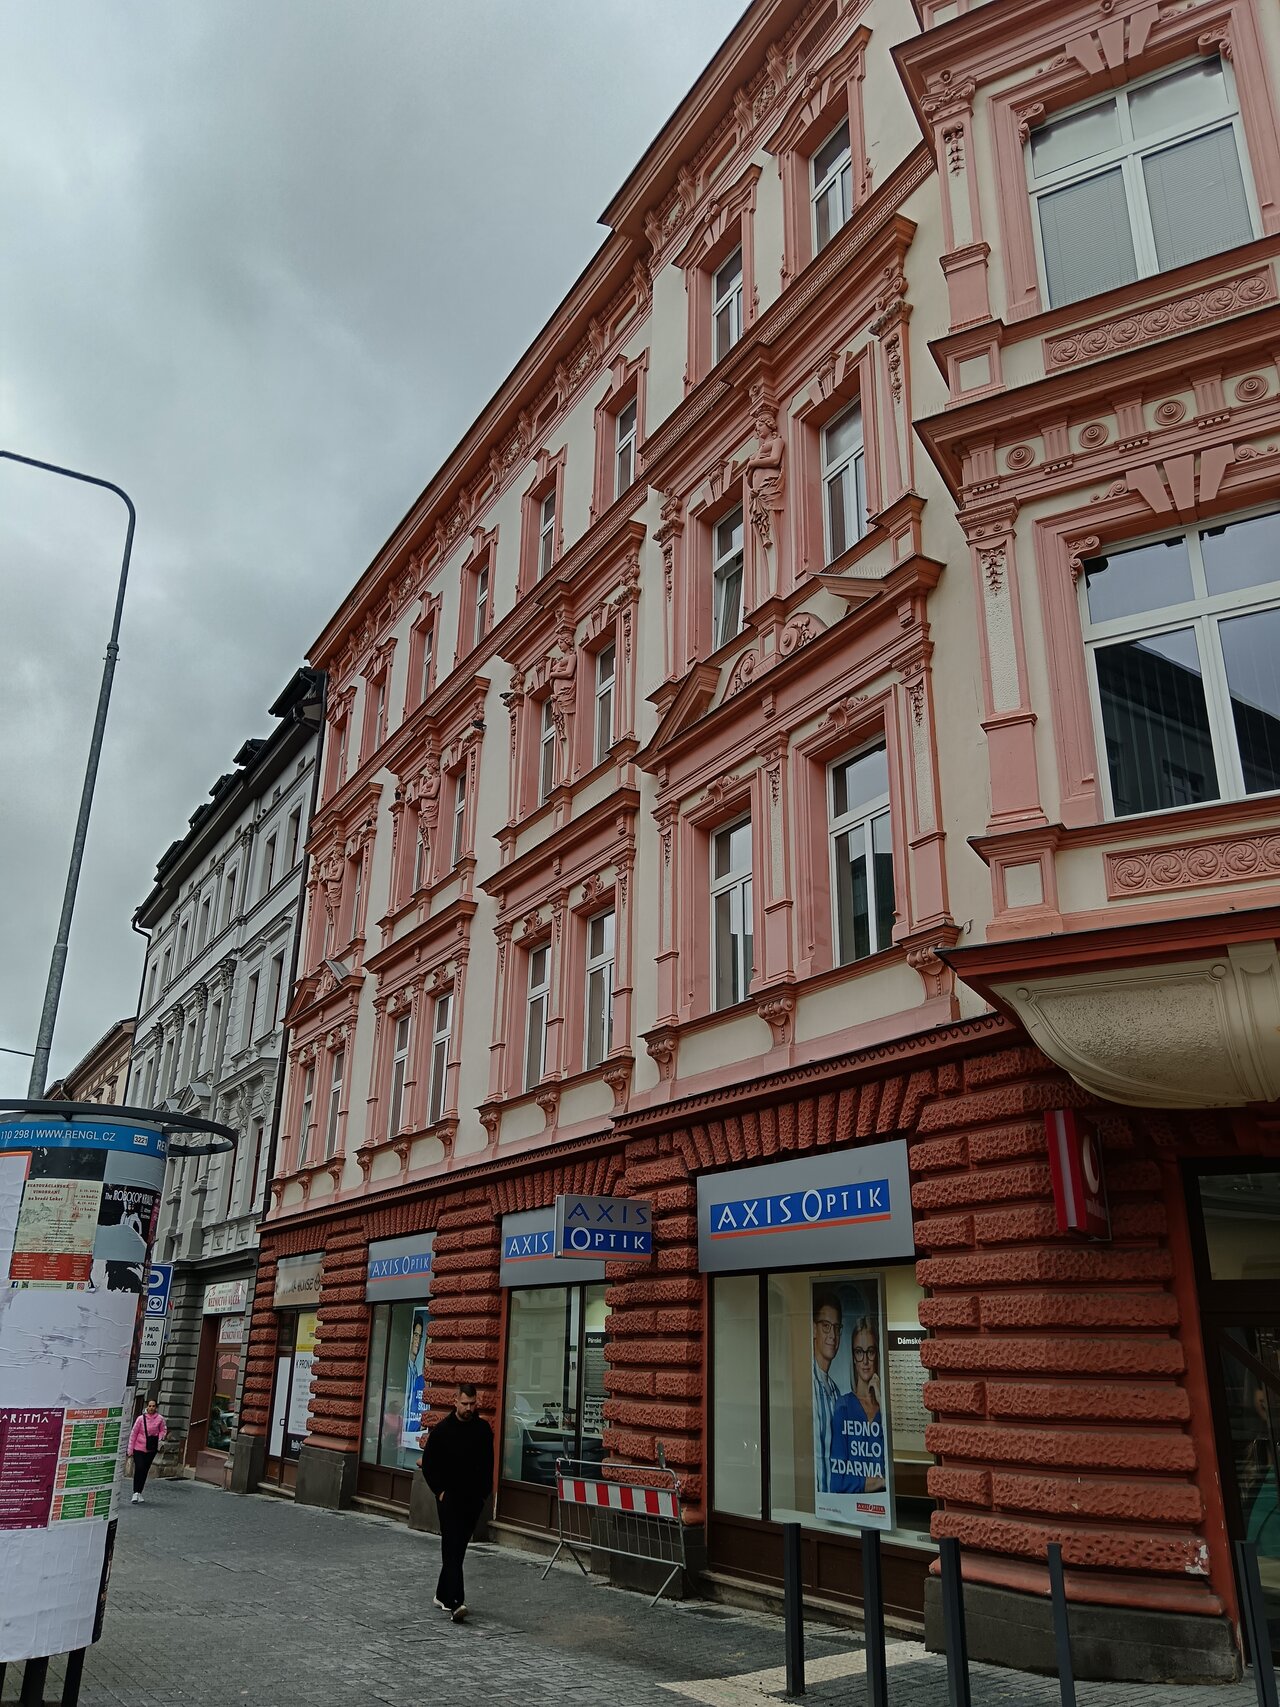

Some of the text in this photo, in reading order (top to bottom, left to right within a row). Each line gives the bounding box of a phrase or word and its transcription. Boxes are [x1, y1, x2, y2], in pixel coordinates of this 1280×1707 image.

[14, 1129, 30, 1139] 298
[36, 1130, 116, 1142] WWW.RENGL.CZ
[567, 1202, 647, 1225] AXIS
[717, 1187, 882, 1230] AXIS OPTIK
[508, 1232, 549, 1256] AXIS
[570, 1226, 645, 1250] OPTIK
[371, 1255, 429, 1277] AXIS OPTIK
[897, 1336, 922, 1345] Dámské
[841, 1420, 880, 1437] JEDNO
[850, 1440, 882, 1458] SKLO
[830, 1458, 883, 1478] ZDARMA
